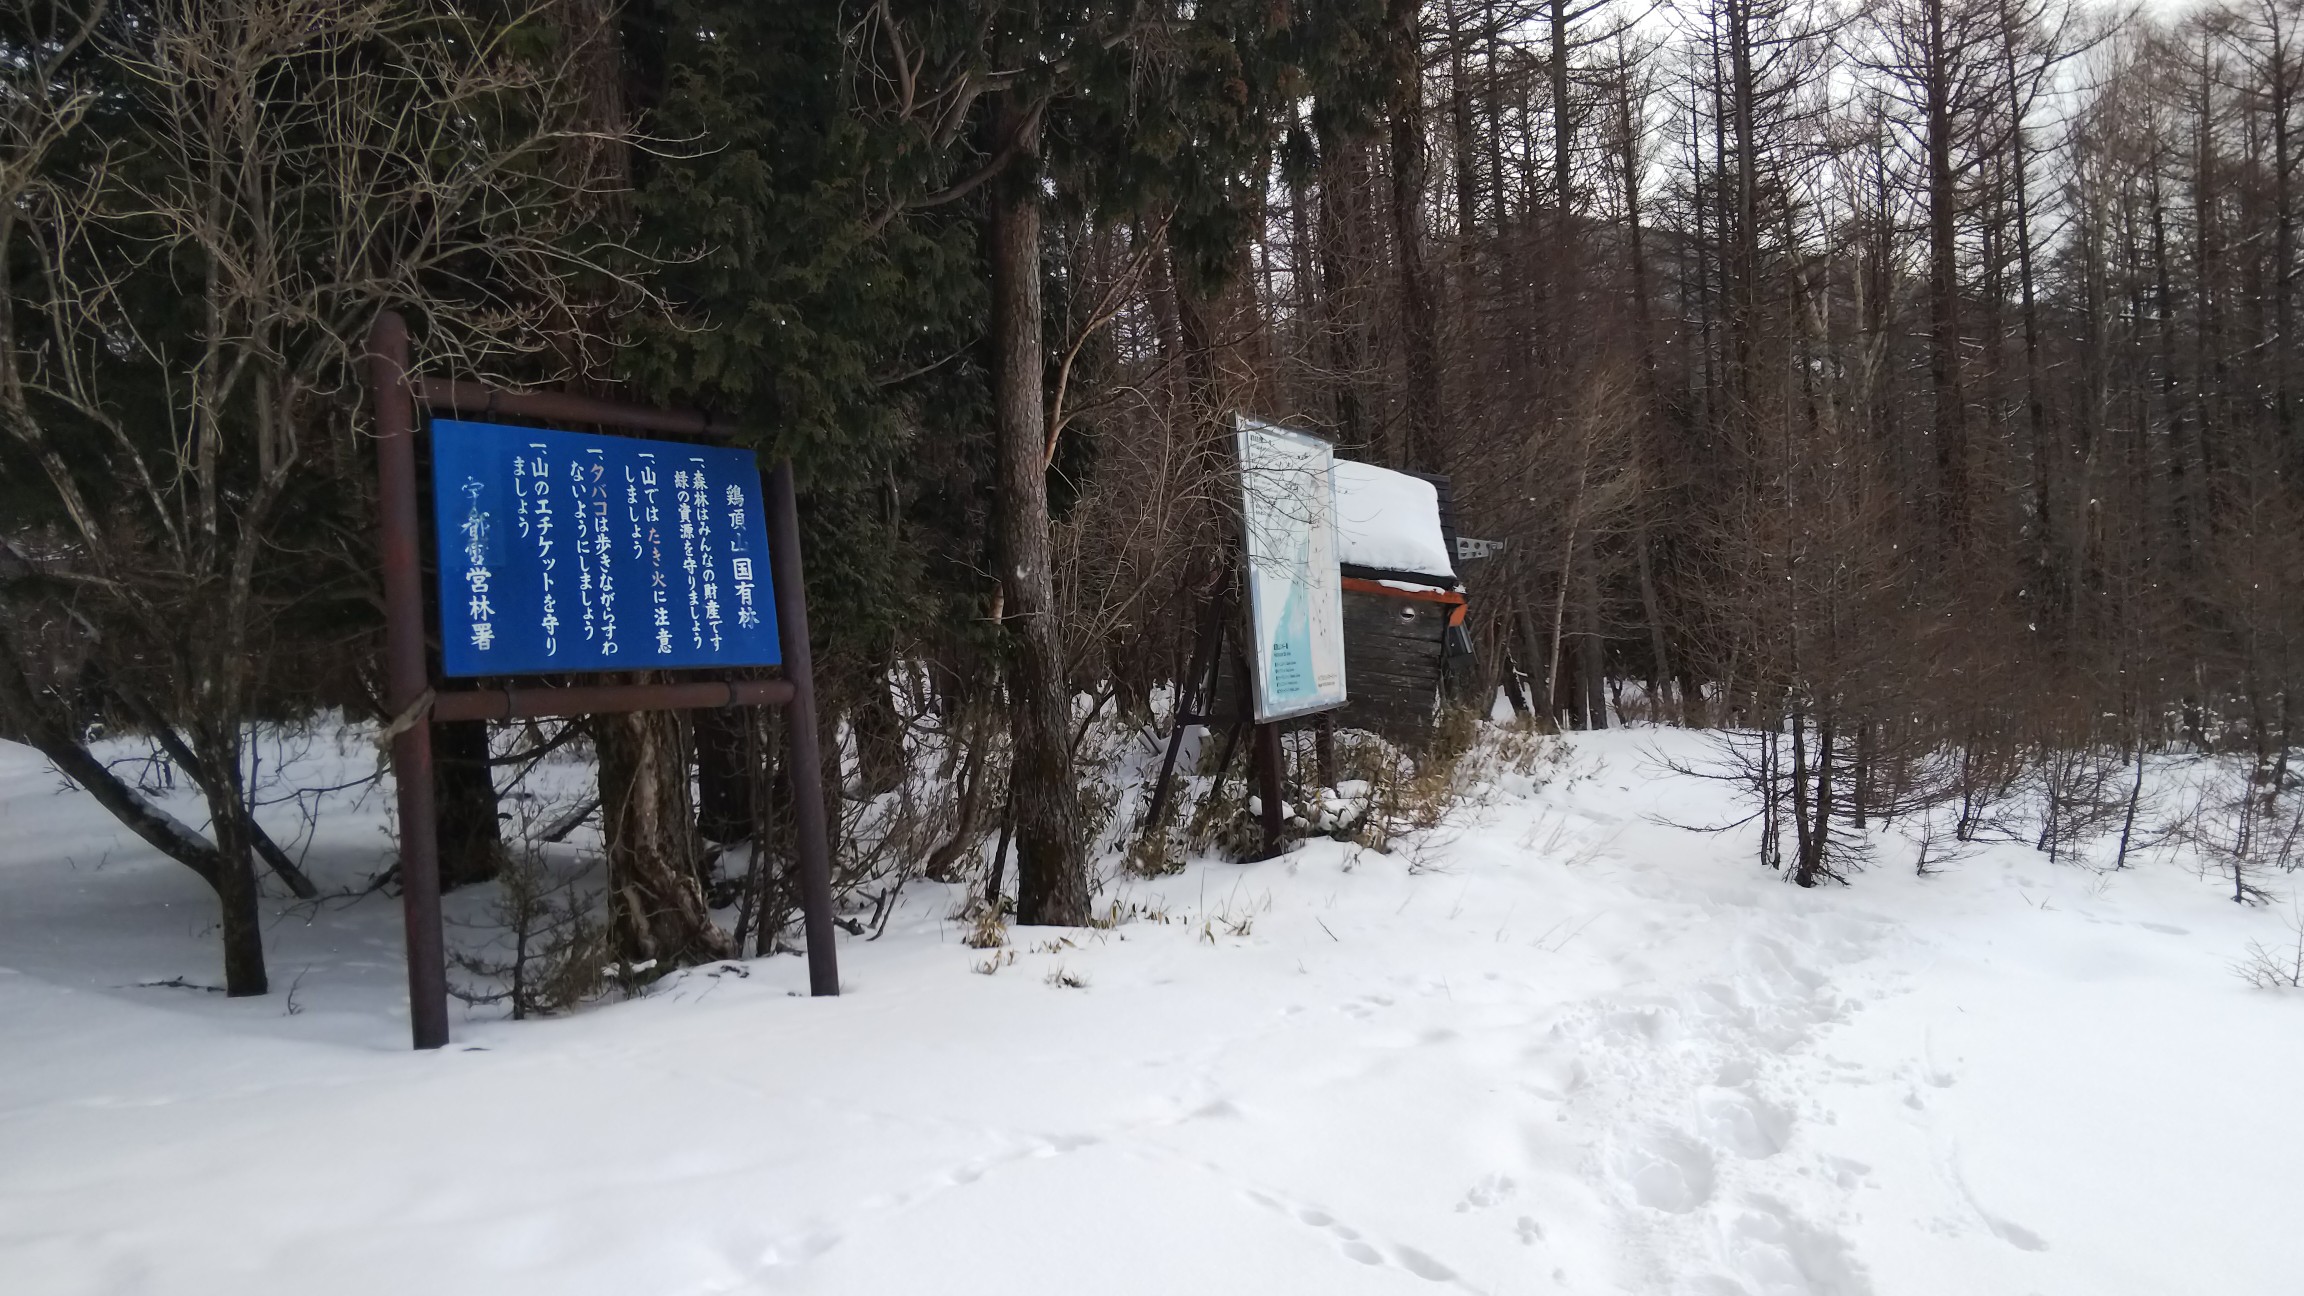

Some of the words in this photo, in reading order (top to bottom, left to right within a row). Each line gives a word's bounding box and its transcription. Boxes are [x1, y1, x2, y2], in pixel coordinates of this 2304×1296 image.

[513, 456, 531, 539] ましょう
[570, 460, 595, 641] ないようにしましょう
[625, 465, 643, 560] しましょう
[674, 470, 703, 650] 緑の資源を守りましょう
